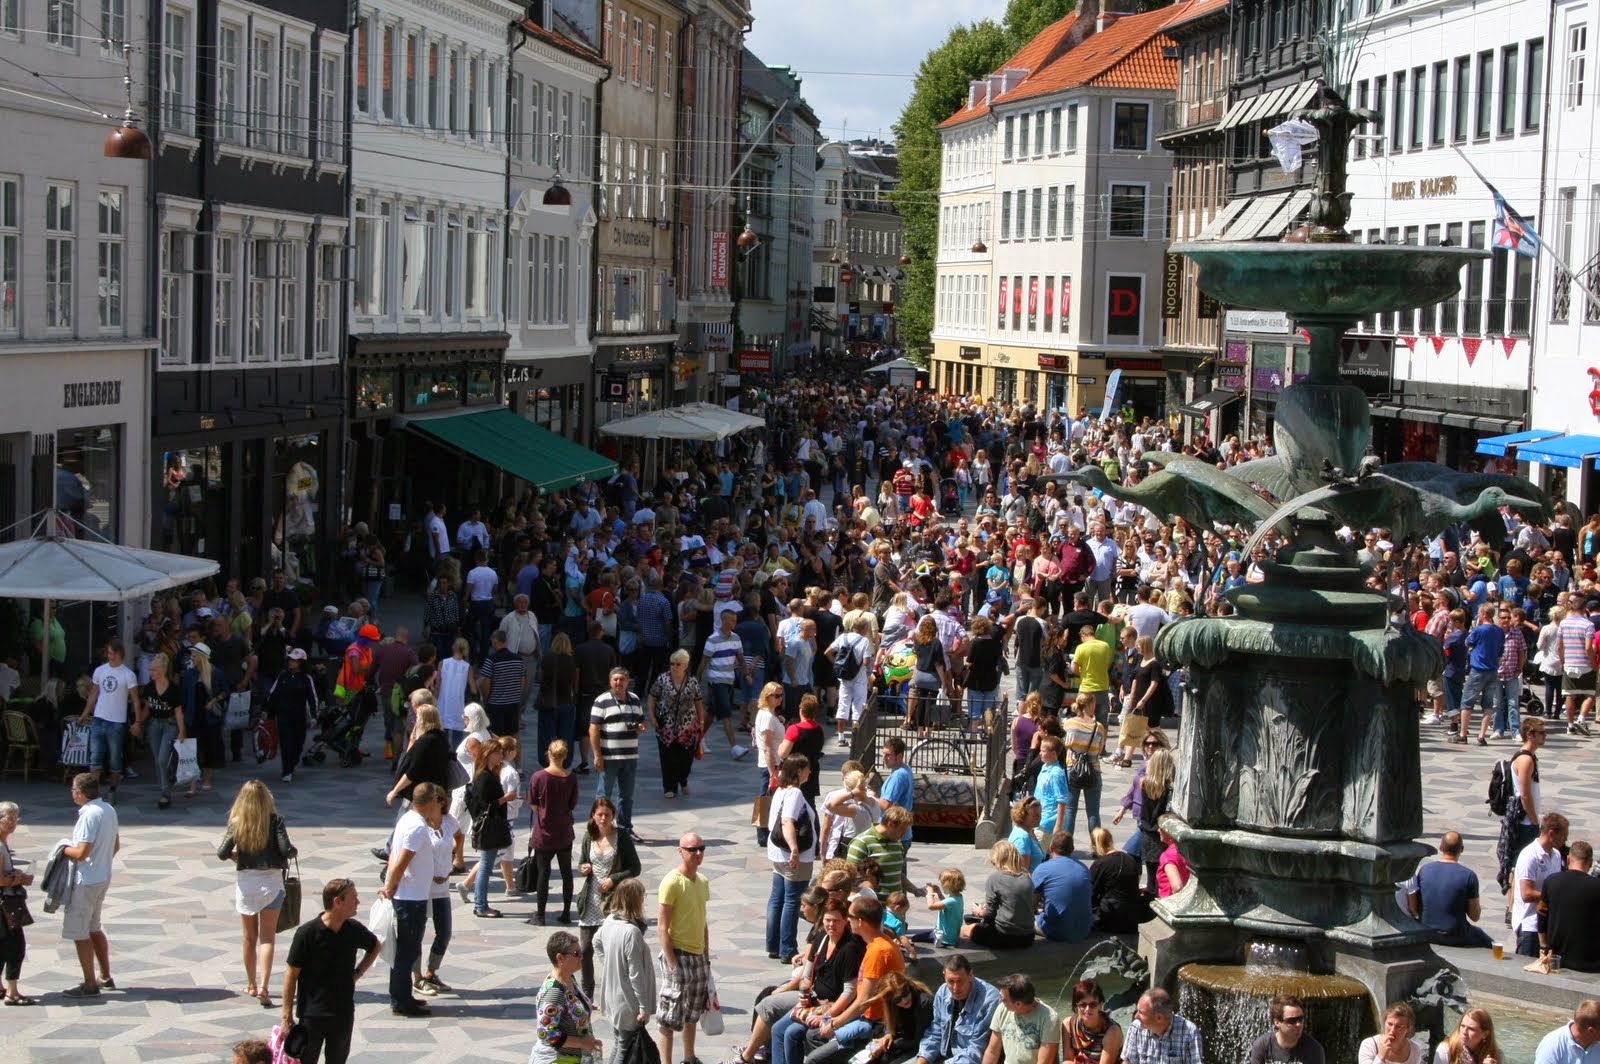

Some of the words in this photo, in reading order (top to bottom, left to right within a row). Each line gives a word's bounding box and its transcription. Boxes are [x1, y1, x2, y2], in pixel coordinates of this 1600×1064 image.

[713, 231, 727, 239] DTZ
[719, 242, 727, 279] KONTOR
[1166, 253, 1178, 315] MONSOON
[1111, 289, 1138, 316] D
[1358, 367, 1389, 377] Bolighus
